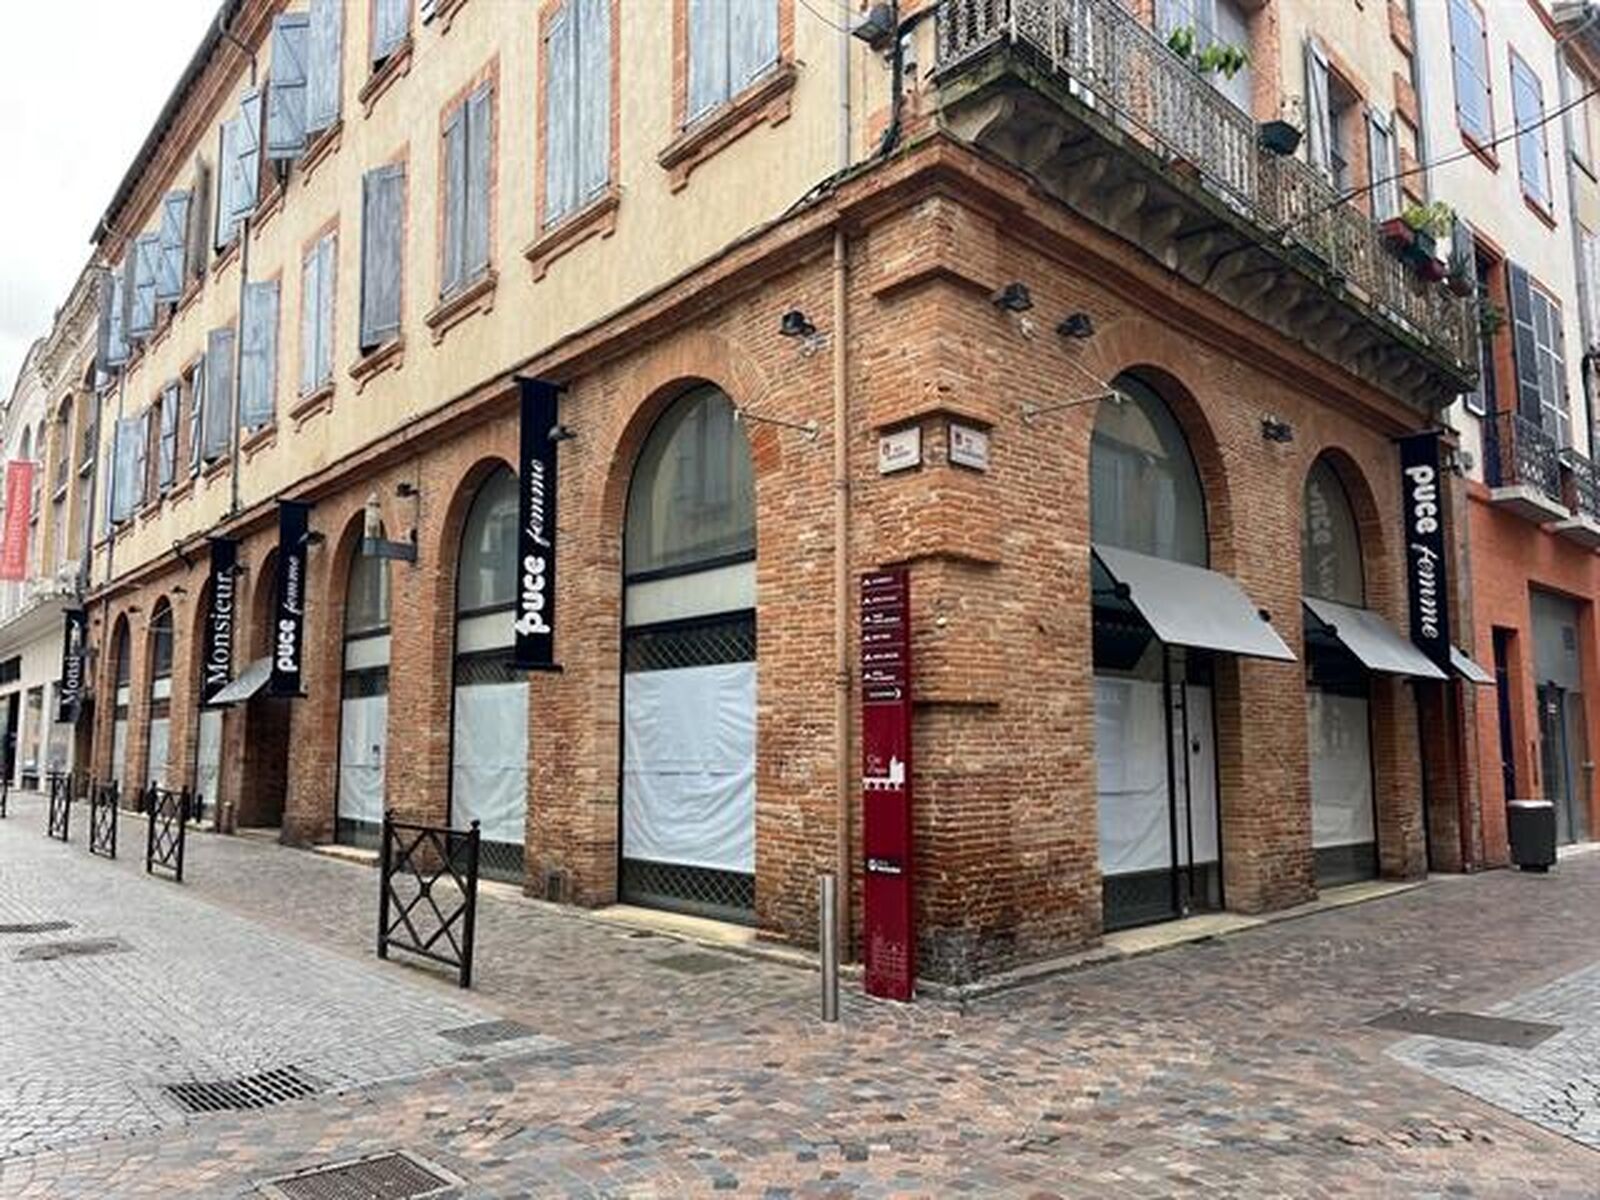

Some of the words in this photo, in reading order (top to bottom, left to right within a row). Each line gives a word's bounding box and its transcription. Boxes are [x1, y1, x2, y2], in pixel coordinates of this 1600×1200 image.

[525, 459, 550, 546] femme
[1405, 464, 1438, 535] puce
[282, 554, 301, 615] femme
[515, 554, 550, 636] puce
[1411, 543, 1440, 639] femme
[207, 572, 233, 685] Monsieur
[276, 619, 298, 672] puce
